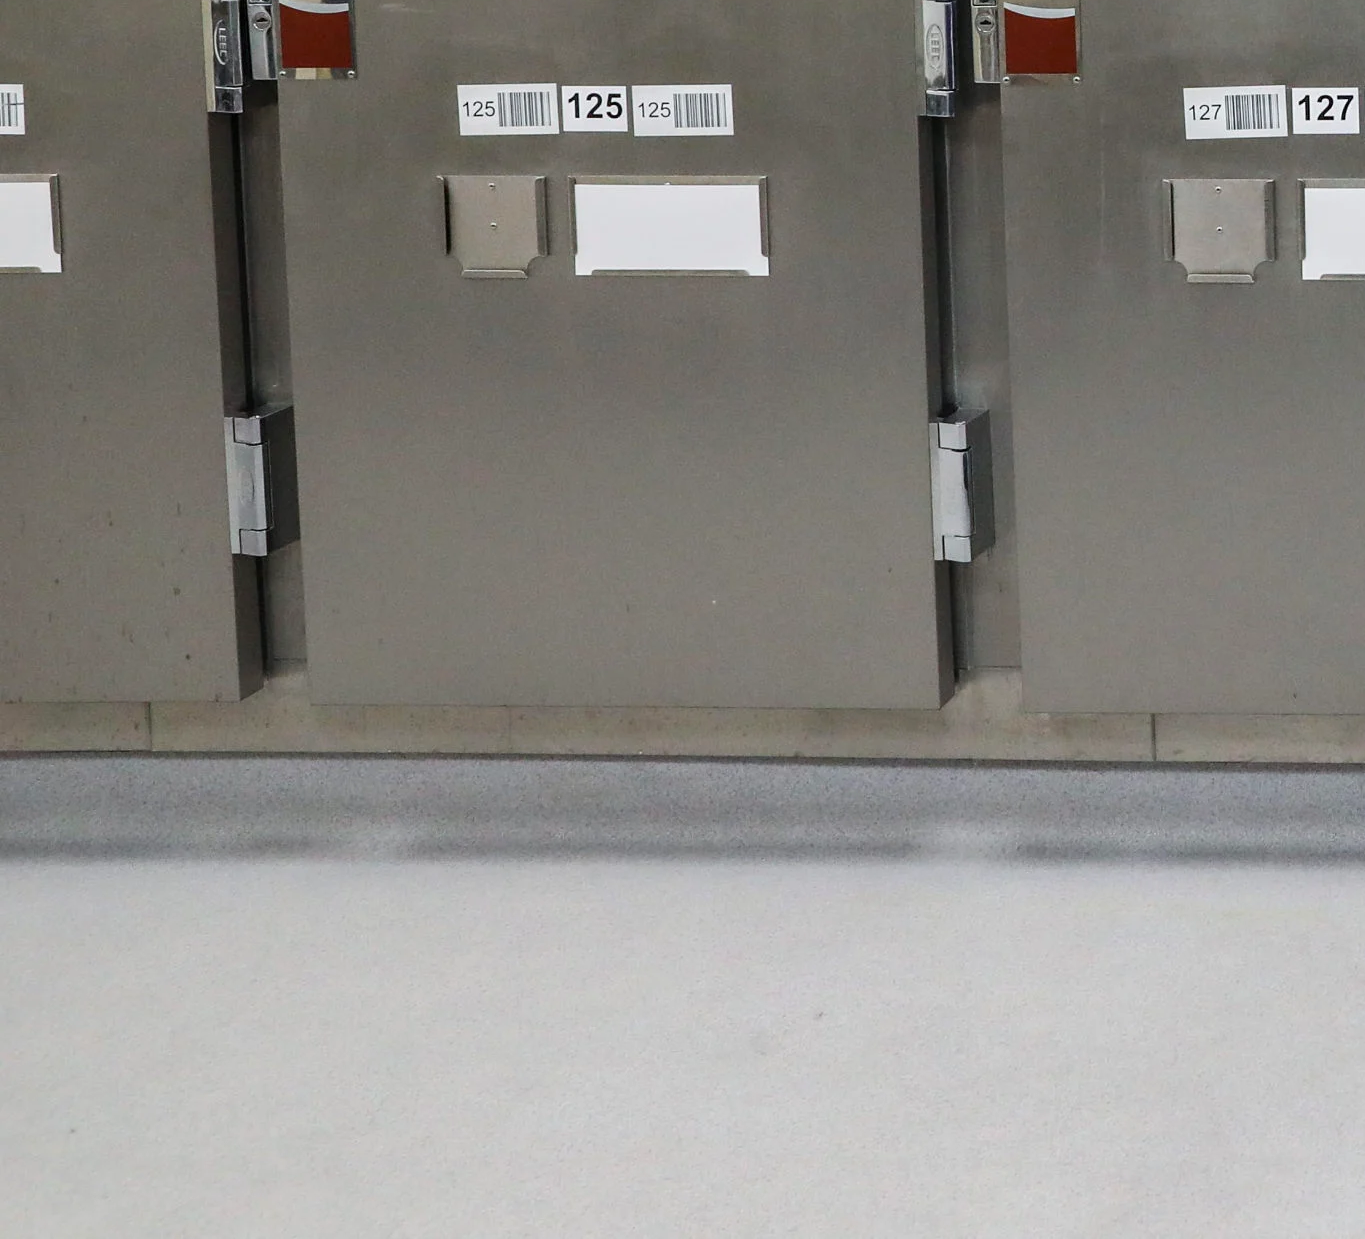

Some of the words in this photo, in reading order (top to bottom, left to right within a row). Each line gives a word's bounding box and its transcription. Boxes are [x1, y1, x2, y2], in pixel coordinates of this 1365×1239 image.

[462, 100, 496, 117] 125
[567, 92, 623, 119] 125
[638, 101, 671, 118] 125
[1188, 104, 1222, 121] 127
[1297, 94, 1354, 121] 127
